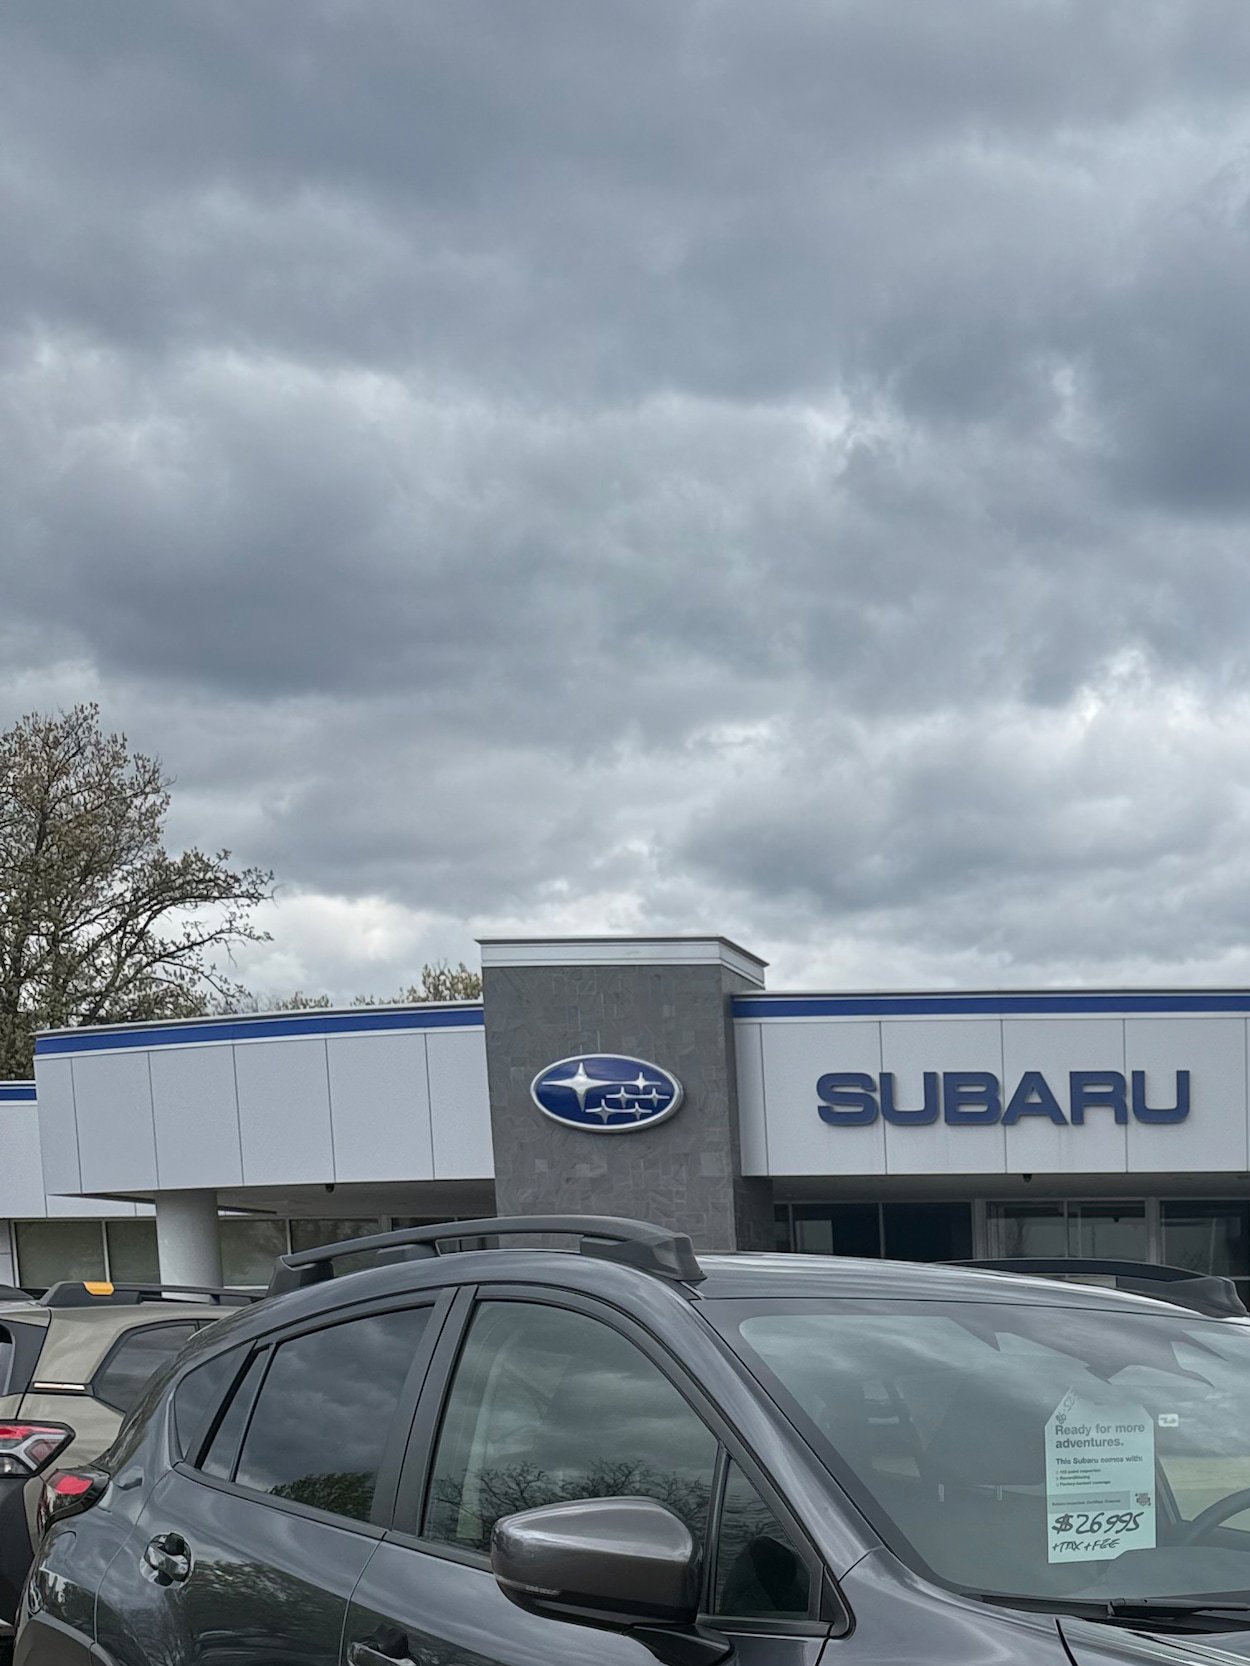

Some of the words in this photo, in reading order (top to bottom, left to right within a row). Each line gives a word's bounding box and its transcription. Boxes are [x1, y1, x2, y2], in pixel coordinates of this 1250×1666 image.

[816, 1069, 1190, 1126] SUBARU
[1055, 1423, 1092, 1437] Ready
[1095, 1423, 1112, 1434] for
[1115, 1424, 1145, 1433] more
[1055, 1437, 1124, 1448] adventures.
[1055, 1457, 1071, 1465] This
[1072, 1456, 1099, 1465] Subaru
[1051, 1511, 1145, 1535] $26995
